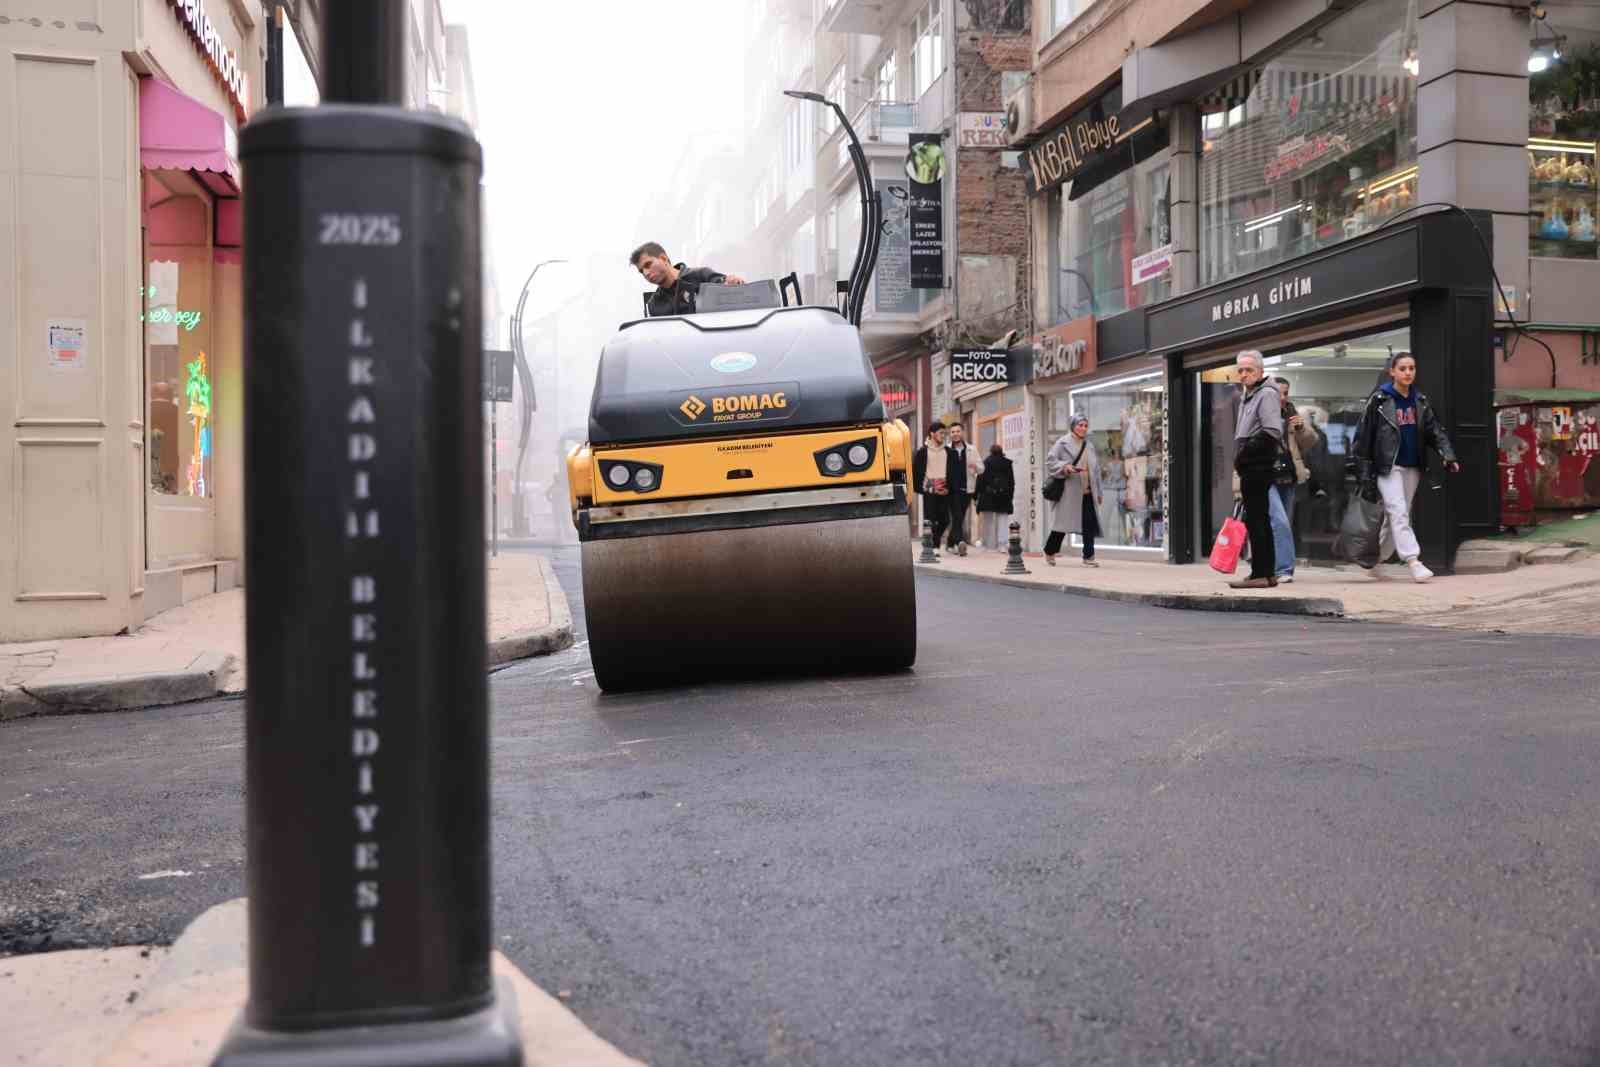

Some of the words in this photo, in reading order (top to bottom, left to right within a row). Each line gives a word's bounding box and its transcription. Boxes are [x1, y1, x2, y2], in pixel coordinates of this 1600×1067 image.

[319, 211, 400, 246] 2025
[968, 351, 992, 360] FOTO
[952, 362, 1008, 380] REKOR
[712, 392, 786, 414] BOMAG
[713, 414, 735, 423] FAYAT
[736, 412, 762, 420] GROUP
